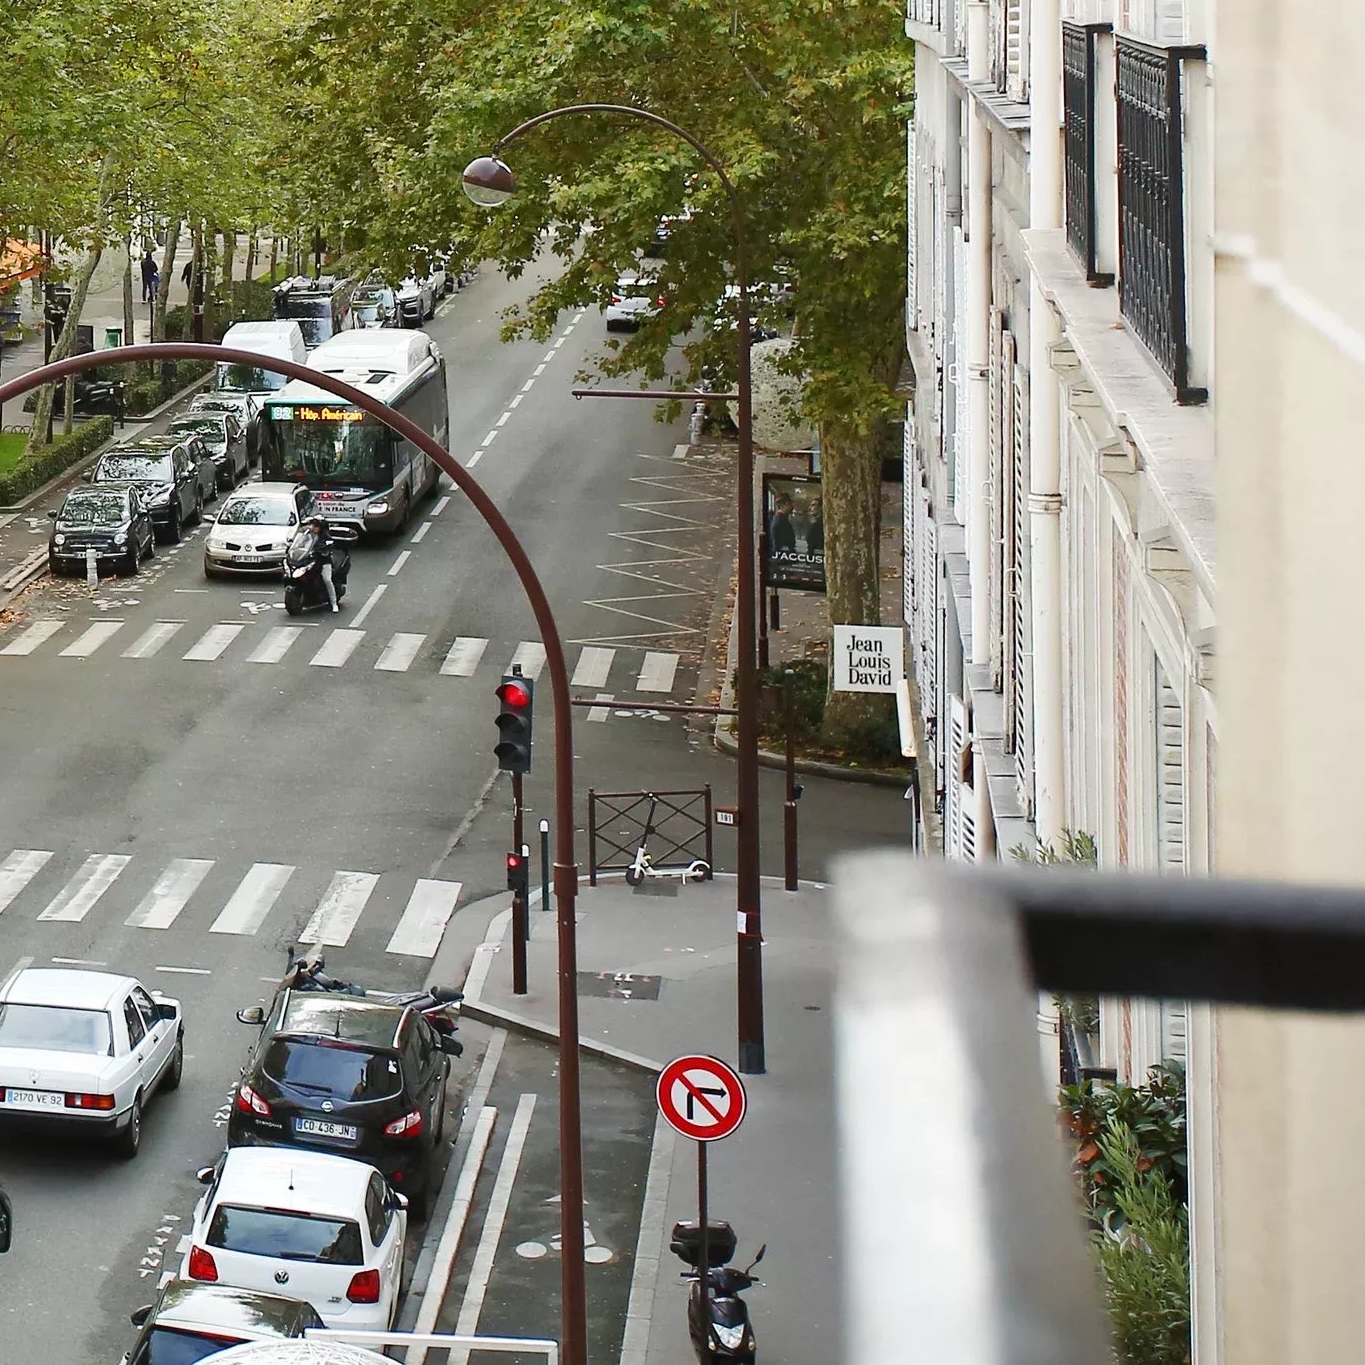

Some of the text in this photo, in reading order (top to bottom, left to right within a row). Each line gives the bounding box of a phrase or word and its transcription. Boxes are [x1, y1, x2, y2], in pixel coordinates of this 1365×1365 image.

[771, 551, 826, 564] J'ACCUS
[846, 634, 883, 652] Jean
[848, 651, 891, 669] Louis
[848, 668, 892, 686] David
[13, 1092, 62, 1105] 2170 VE 92
